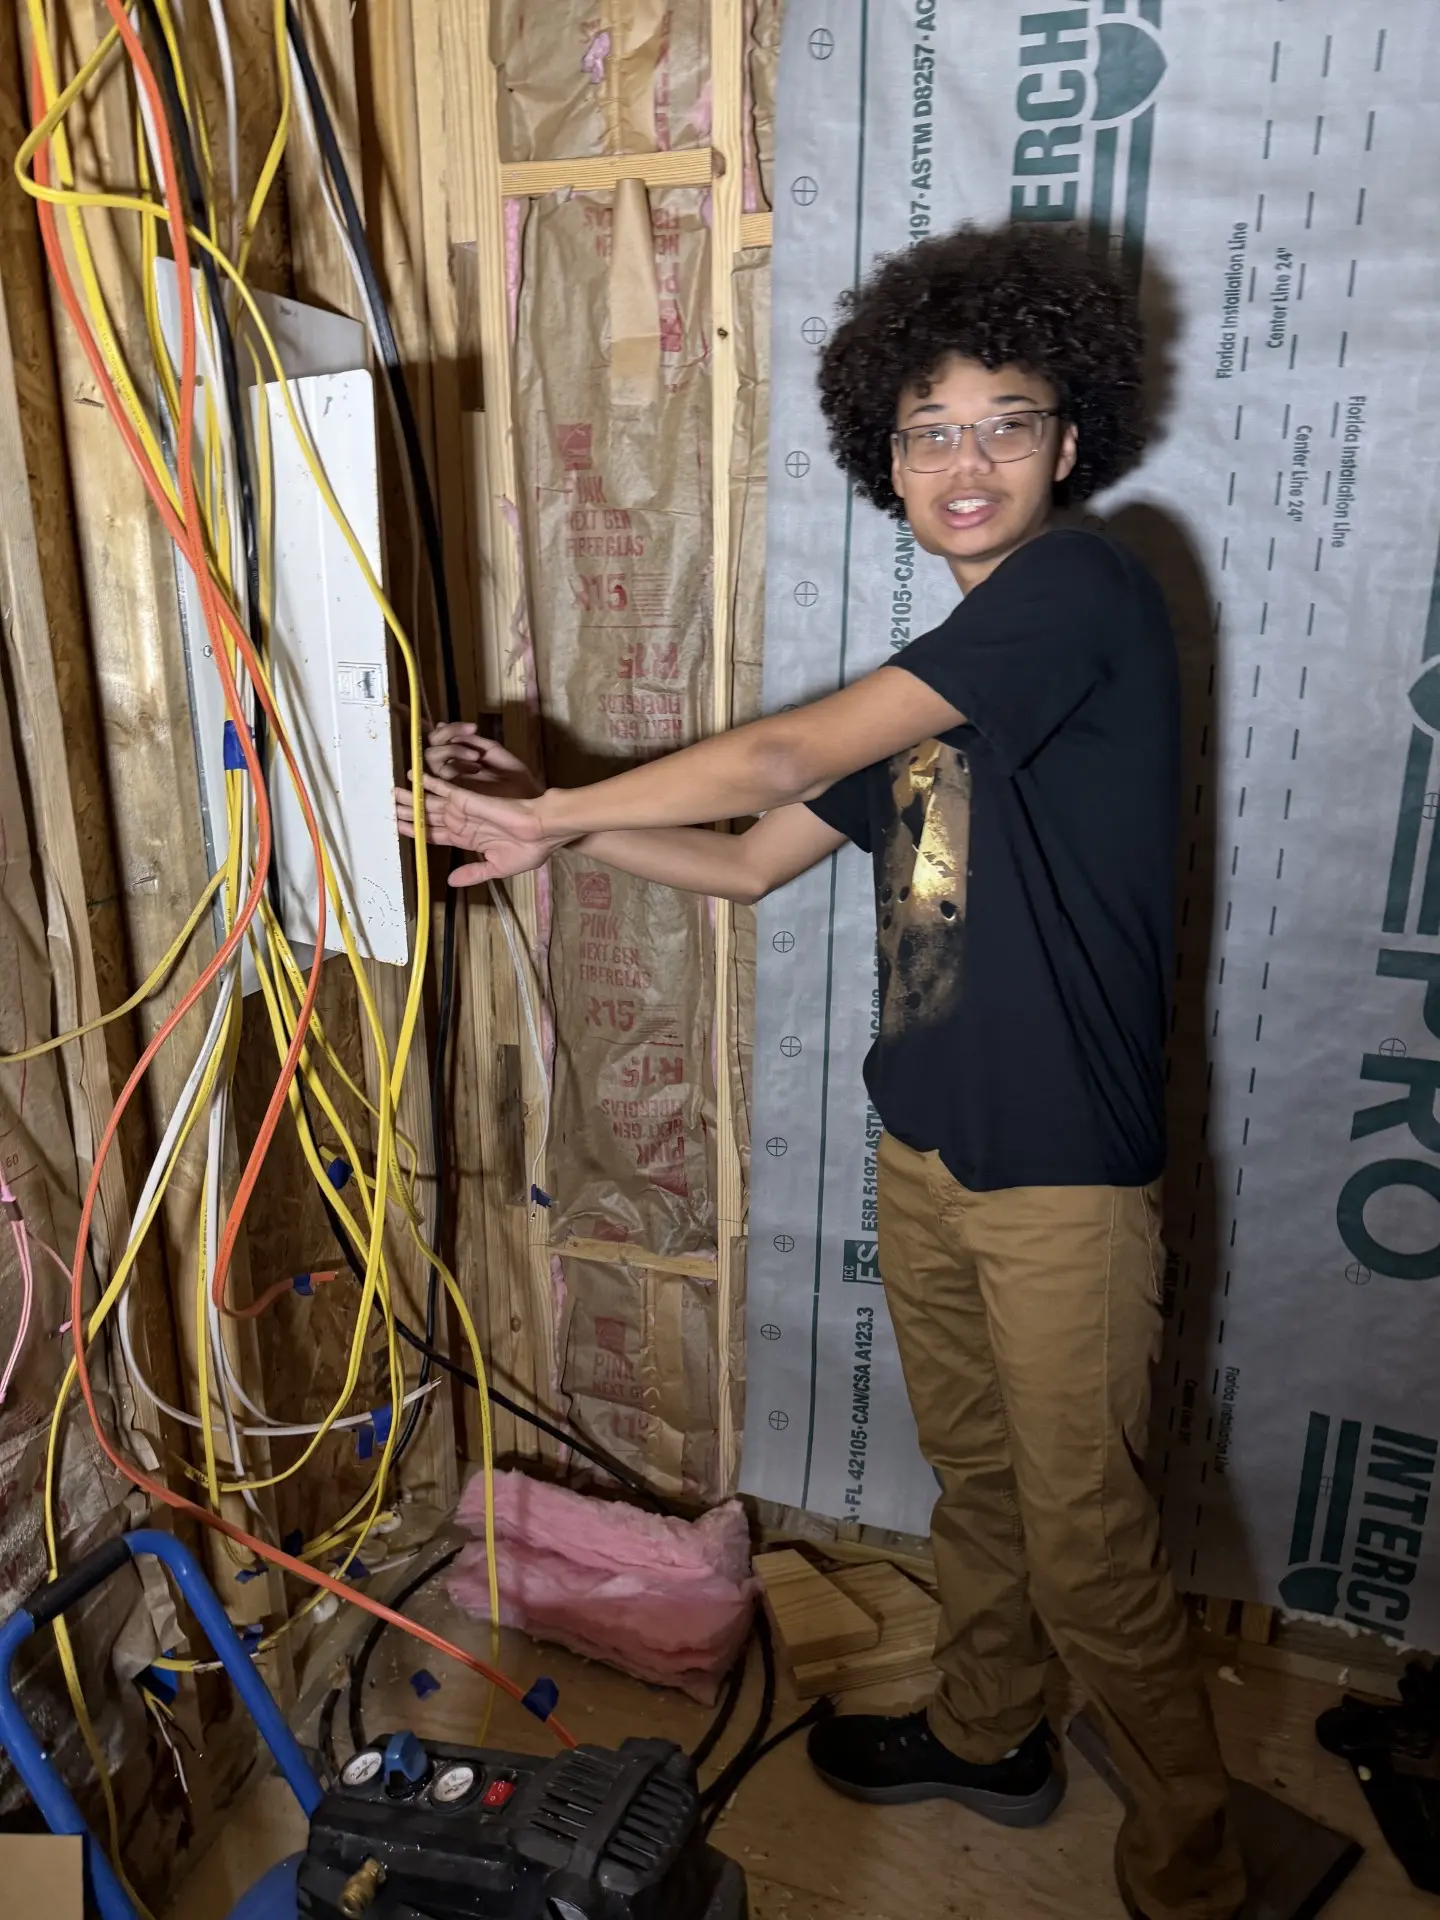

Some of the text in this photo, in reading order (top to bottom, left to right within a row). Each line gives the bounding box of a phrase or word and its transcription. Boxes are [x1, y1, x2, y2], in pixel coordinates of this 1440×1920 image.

[913, 43, 935, 119] D8257
[1010, 0, 1089, 222] ERCH
[911, 122, 933, 190] ASTM
[909, 200, 931, 246] 197
[1216, 221, 1248, 379] Florida Installation Line
[1273, 273, 1292, 301] Line
[1267, 303, 1288, 349] Center
[1292, 425, 1312, 469] Center
[1290, 470, 1309, 498] Line
[1331, 396, 1366, 548] Florida Installation Line
[580, 913, 619, 940] PINK
[621, 1056, 684, 1088] R15
[635, 1136, 685, 1165] PINK
[843, 1265, 855, 1280] ICC
[855, 1306, 874, 1362] A123.3
[852, 1363, 871, 1425] CAN/CSA
[848, 1428, 868, 1480] 42105
[844, 1484, 863, 1506] FL
